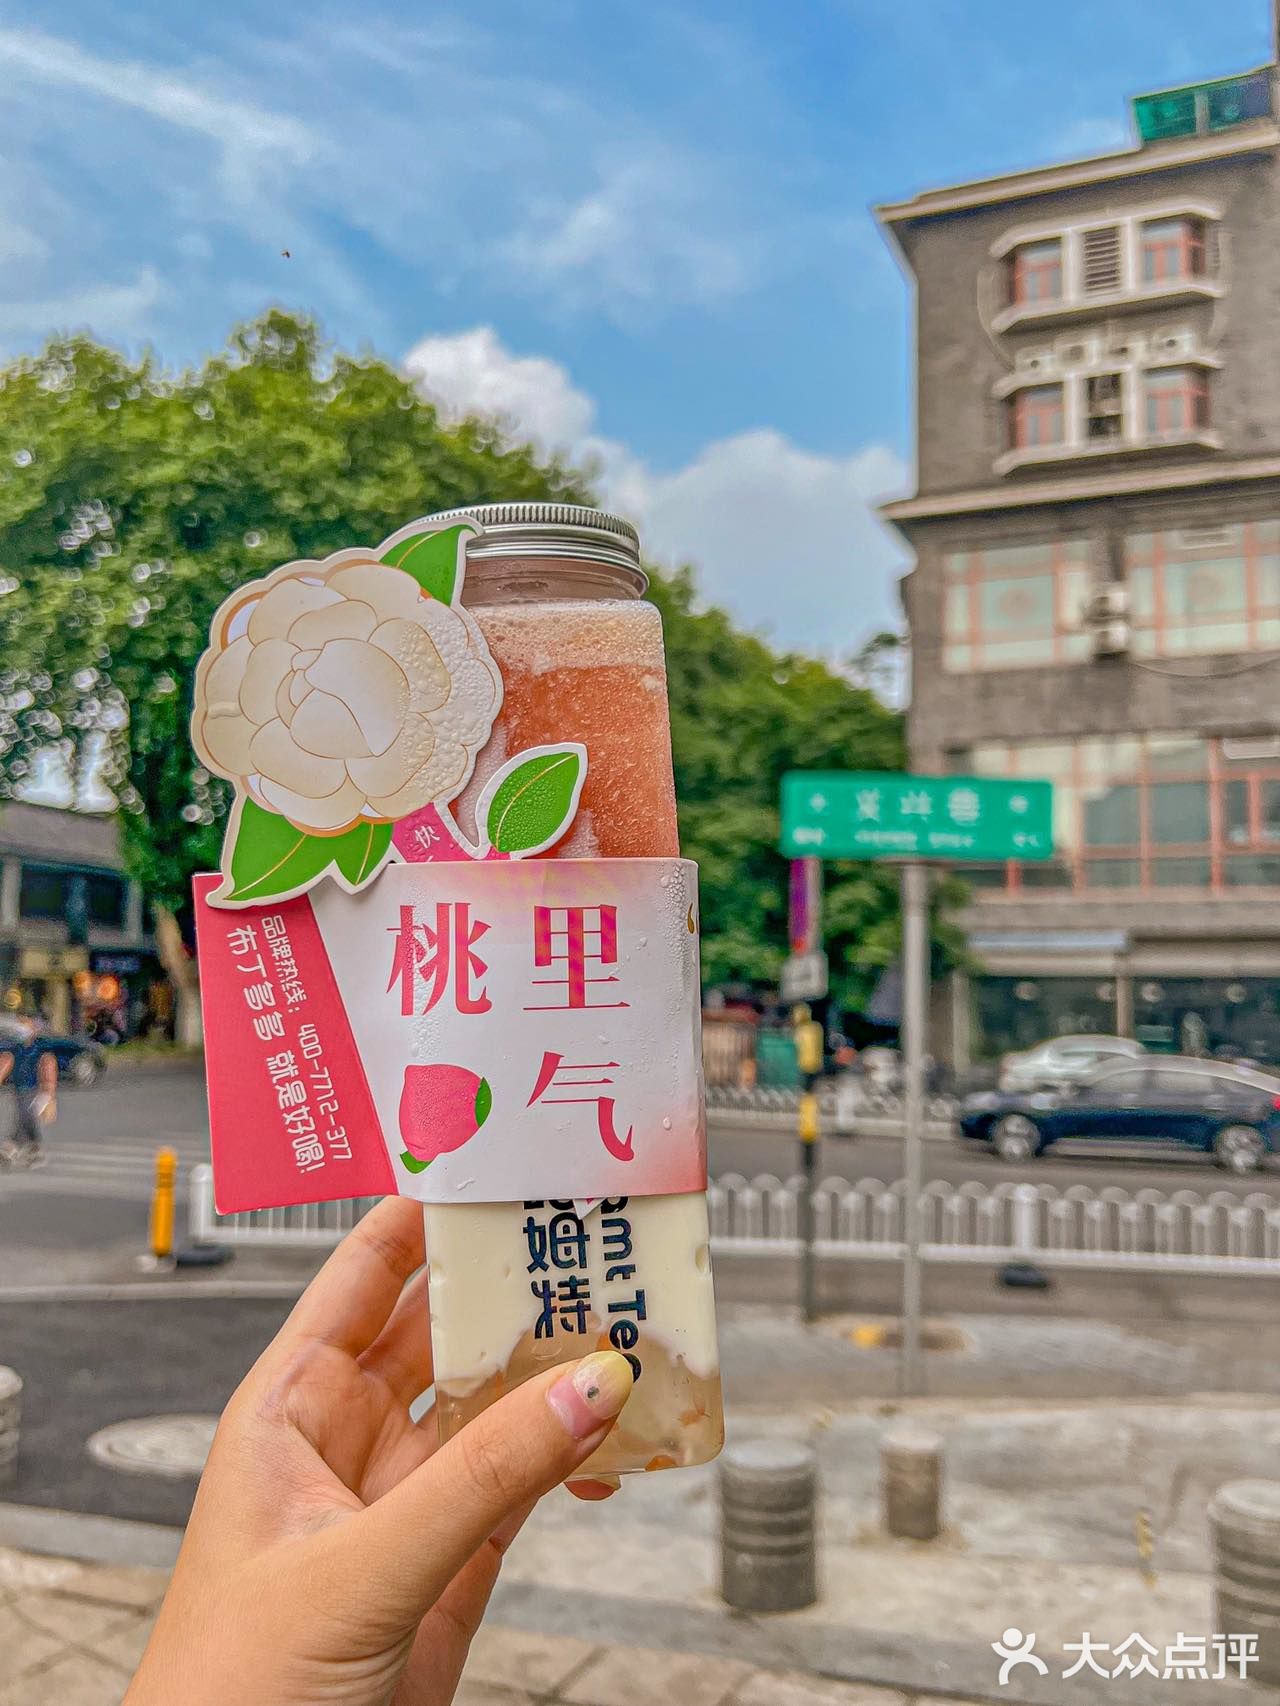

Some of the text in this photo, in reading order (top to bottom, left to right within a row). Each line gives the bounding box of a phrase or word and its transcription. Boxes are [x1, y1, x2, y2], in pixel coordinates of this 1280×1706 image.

[226, 926, 285, 1041] 布丁多多
[386, 902, 631, 1016] 桃里
[526, 1051, 635, 1162] 气
[523, 1197, 592, 1340] 姆特
[608, 1289, 645, 1382] Te
